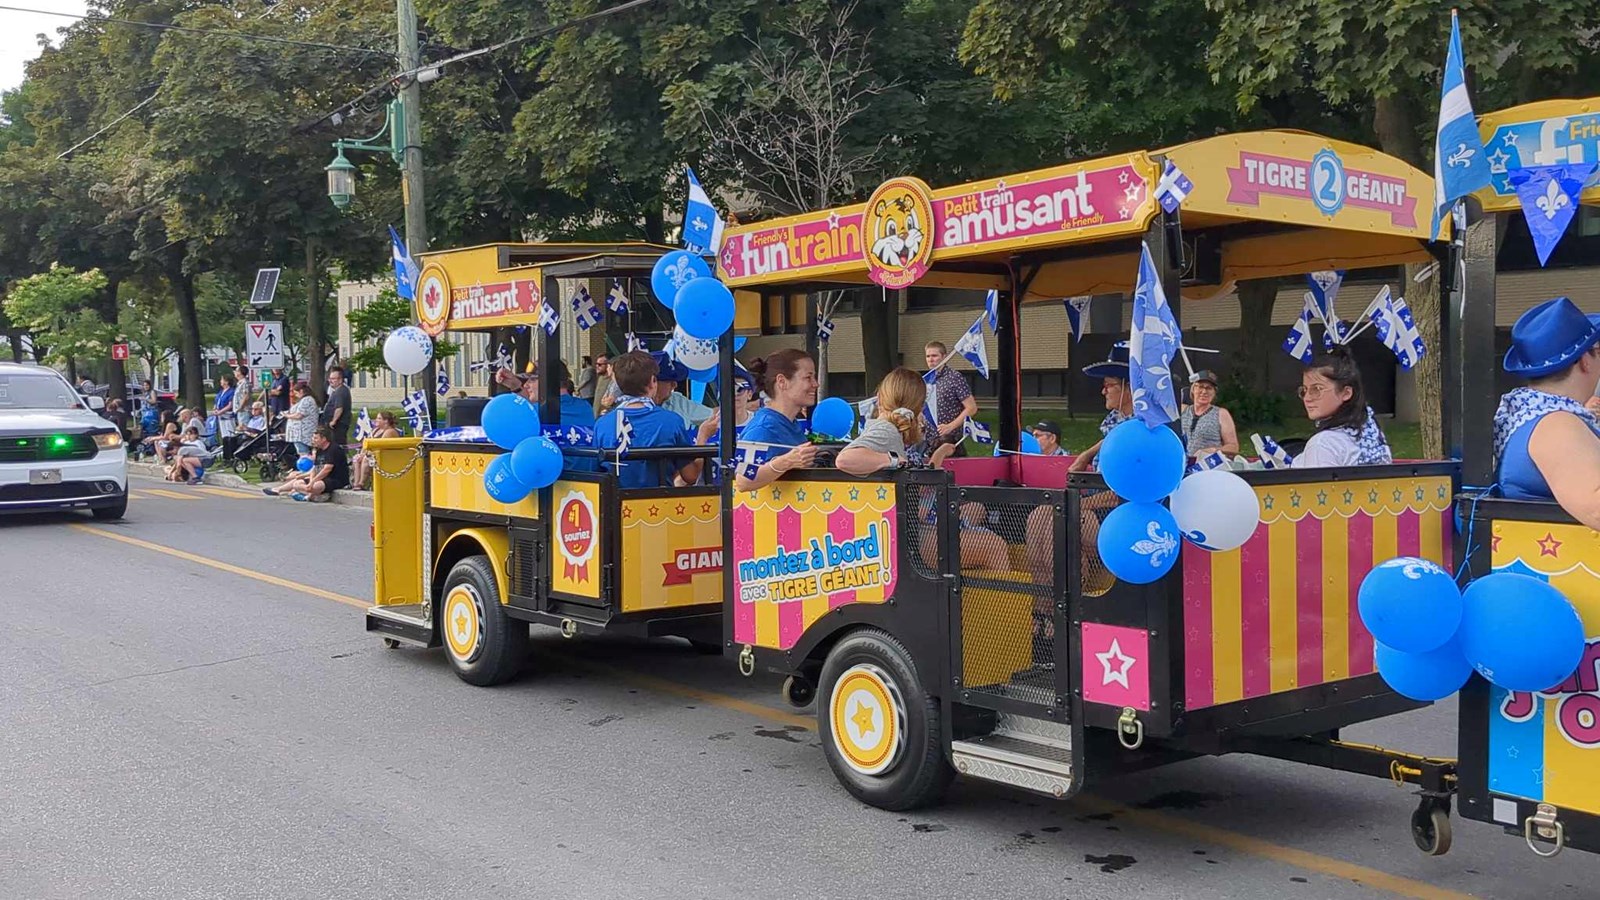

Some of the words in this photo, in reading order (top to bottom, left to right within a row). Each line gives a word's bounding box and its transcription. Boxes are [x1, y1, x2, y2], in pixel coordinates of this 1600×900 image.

[1244, 159, 1306, 190] TIGRE
[1319, 160, 1337, 201] 2
[1347, 173, 1405, 206] GÉANT
[943, 170, 1095, 247] amusant
[944, 194, 978, 218] Petit
[979, 189, 1014, 209] train
[1060, 219, 1071, 230] de
[1072, 212, 1104, 228] Friendly
[753, 229, 788, 246] Friendly's
[452, 280, 519, 320] amusant
[453, 288, 469, 301] Petit
[469, 286, 485, 299] train
[568, 503, 580, 528] #1
[564, 528, 591, 543] souriez
[740, 546, 809, 582] montez
[810, 539, 825, 569] à
[825, 523, 880, 566] bord
[741, 584, 767, 601] avec
[768, 574, 818, 601] TIGRE
[820, 562, 881, 593] GÉANT
